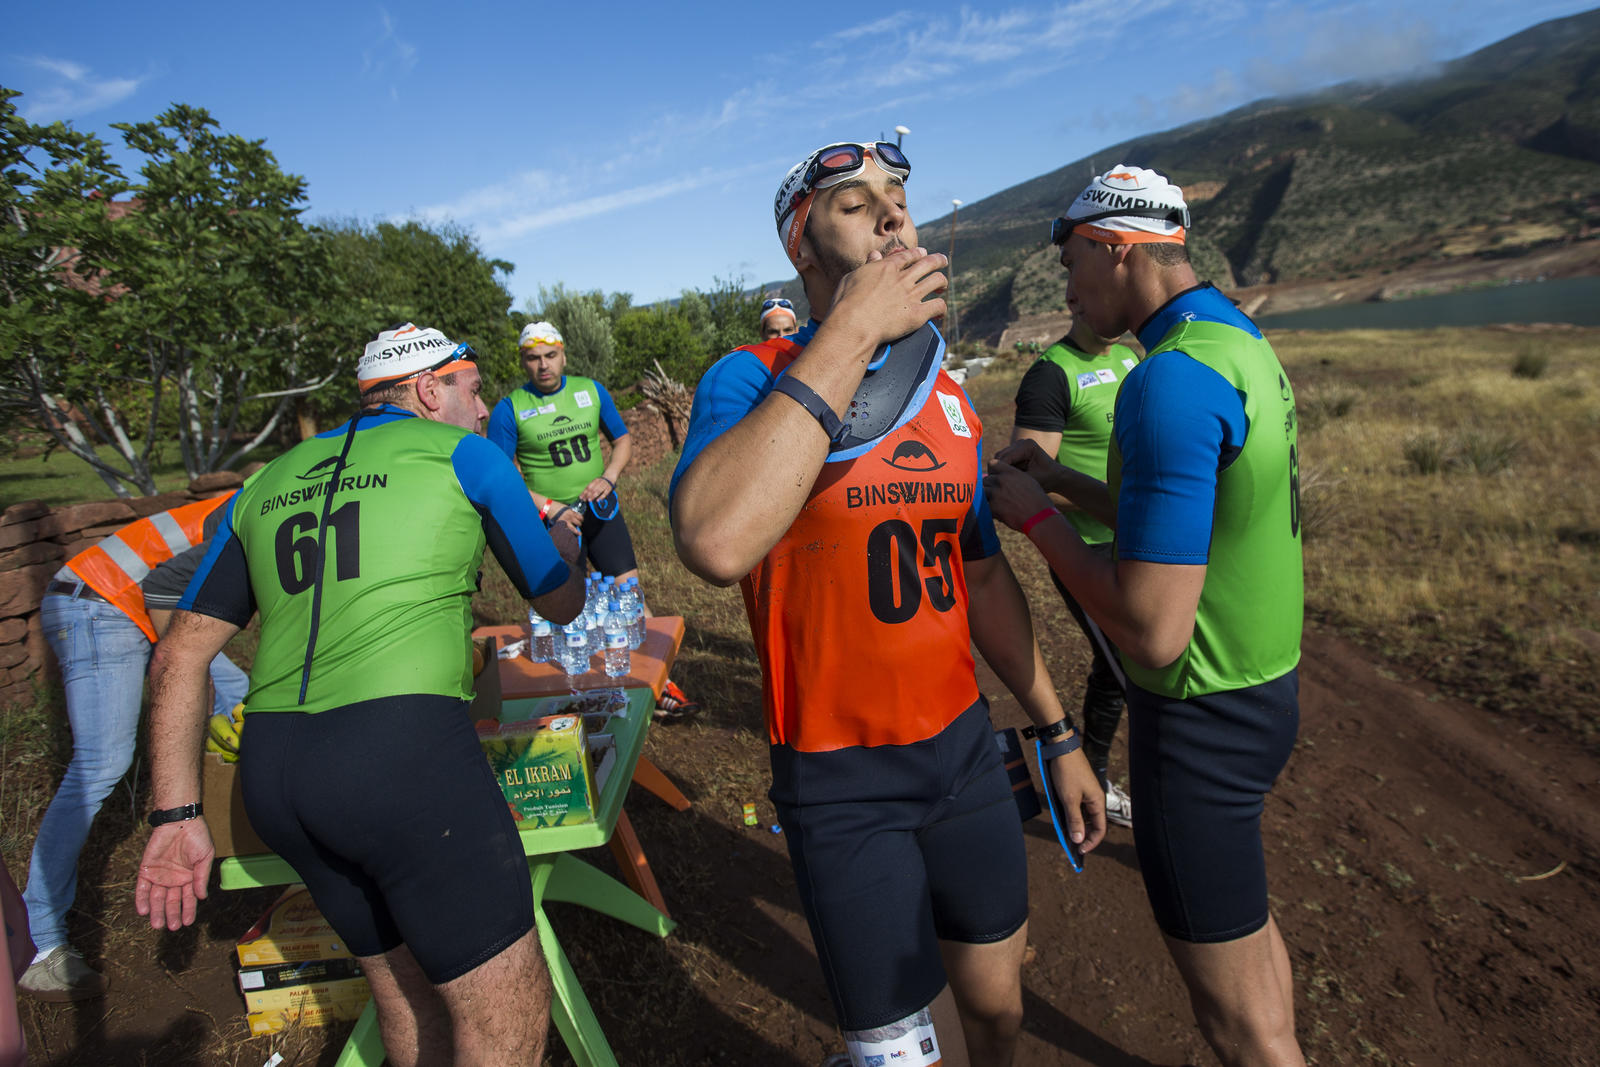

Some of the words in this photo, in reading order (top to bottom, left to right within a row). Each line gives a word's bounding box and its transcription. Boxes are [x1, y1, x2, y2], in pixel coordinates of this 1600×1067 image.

[536, 421, 592, 442] BINSWIMRUN
[548, 433, 592, 468] 60
[260, 473, 388, 517] BINSWIMRUN
[846, 481, 974, 509] BINSWIMRUN
[274, 500, 361, 596] 61
[867, 518, 958, 625] 05
[504, 768, 524, 786] EL
[524, 763, 572, 785] IKRAM
